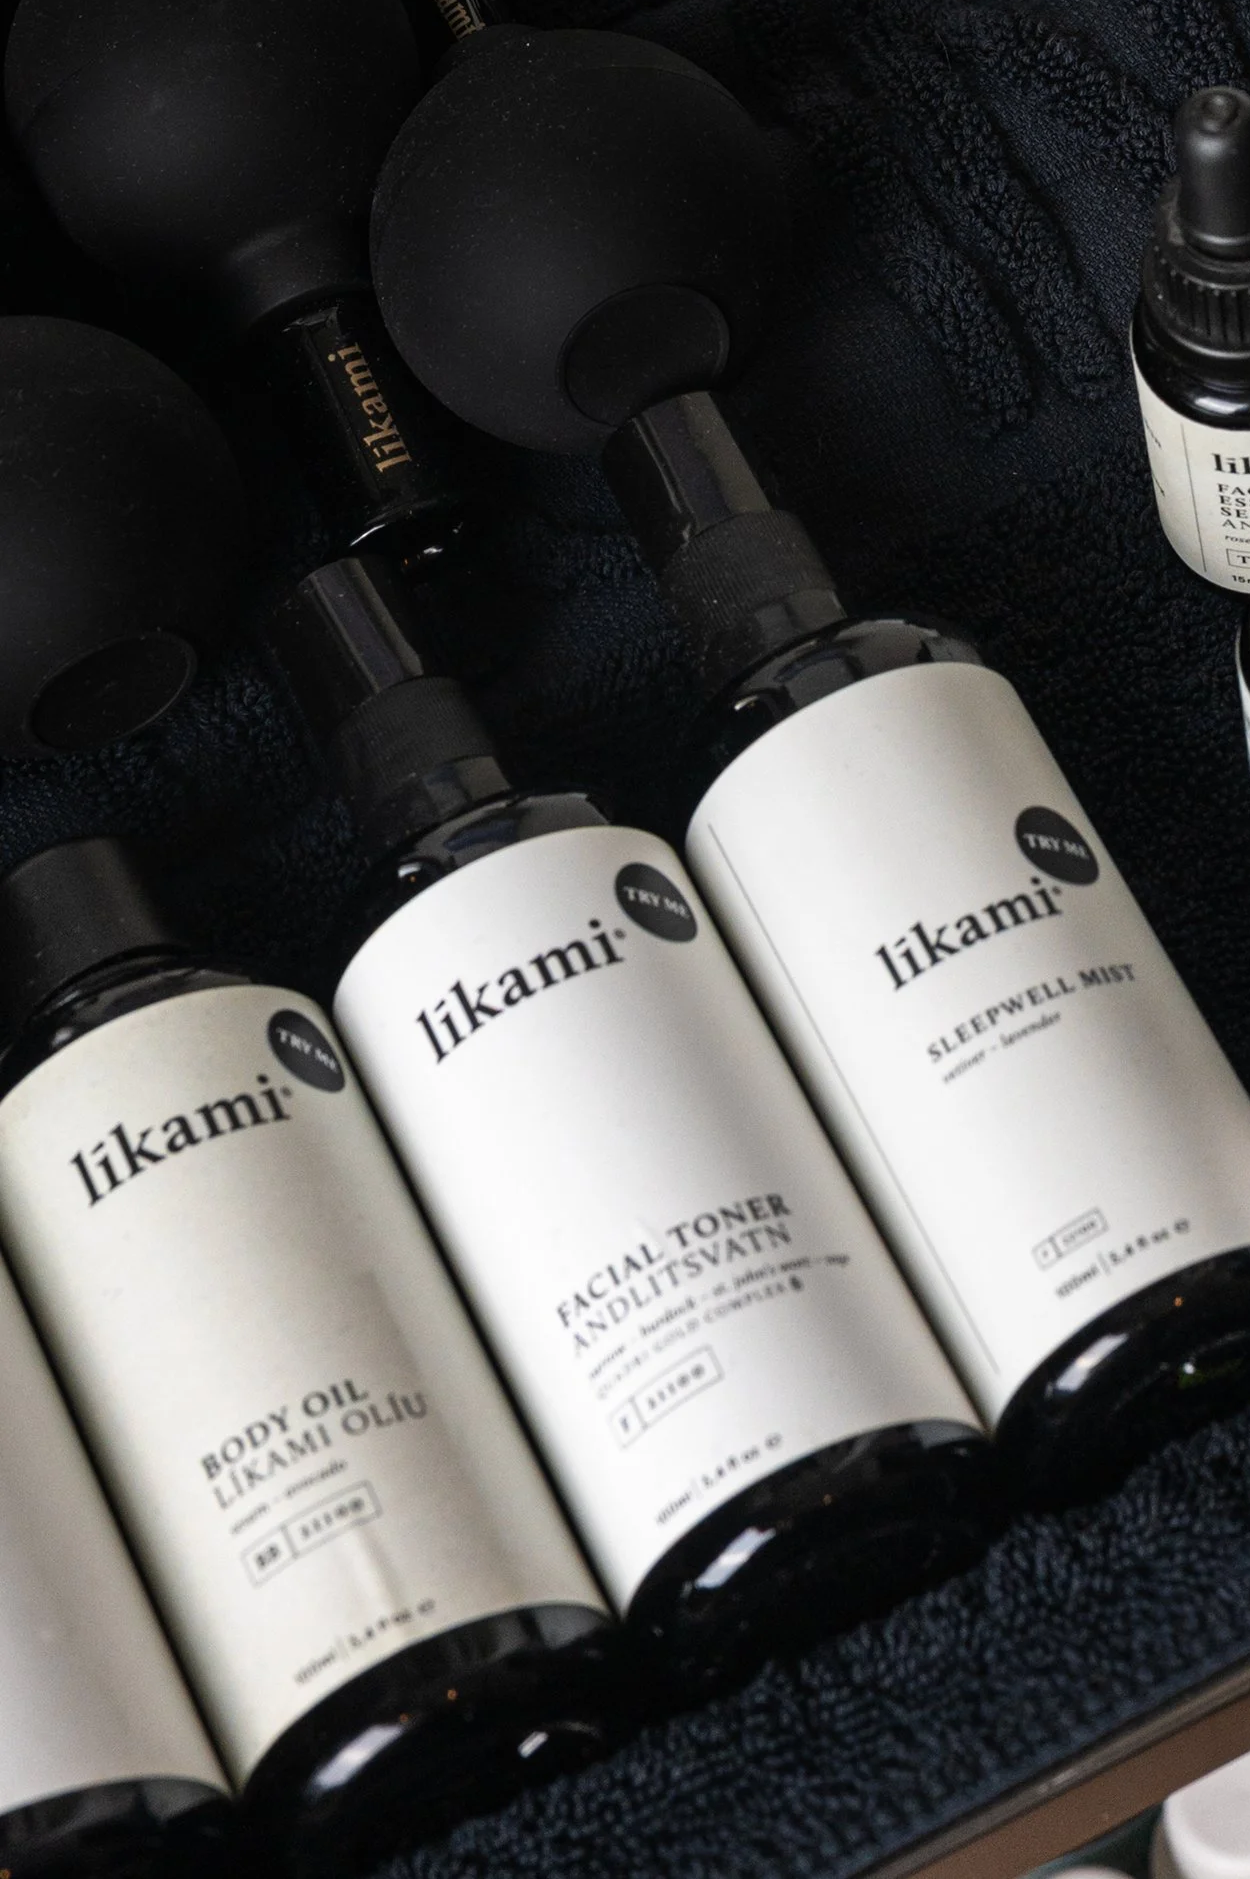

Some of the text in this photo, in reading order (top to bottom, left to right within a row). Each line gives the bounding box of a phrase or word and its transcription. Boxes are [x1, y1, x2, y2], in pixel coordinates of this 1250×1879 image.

[1023, 831, 1061, 853] TRY
[623, 885, 662, 910] TRY
[926, 963, 1139, 1066] SLEEPWELL MIST
[556, 1242, 666, 1330] FACIAL
[665, 1192, 792, 1249] TONER
[201, 1377, 370, 1481] BODY OIL
